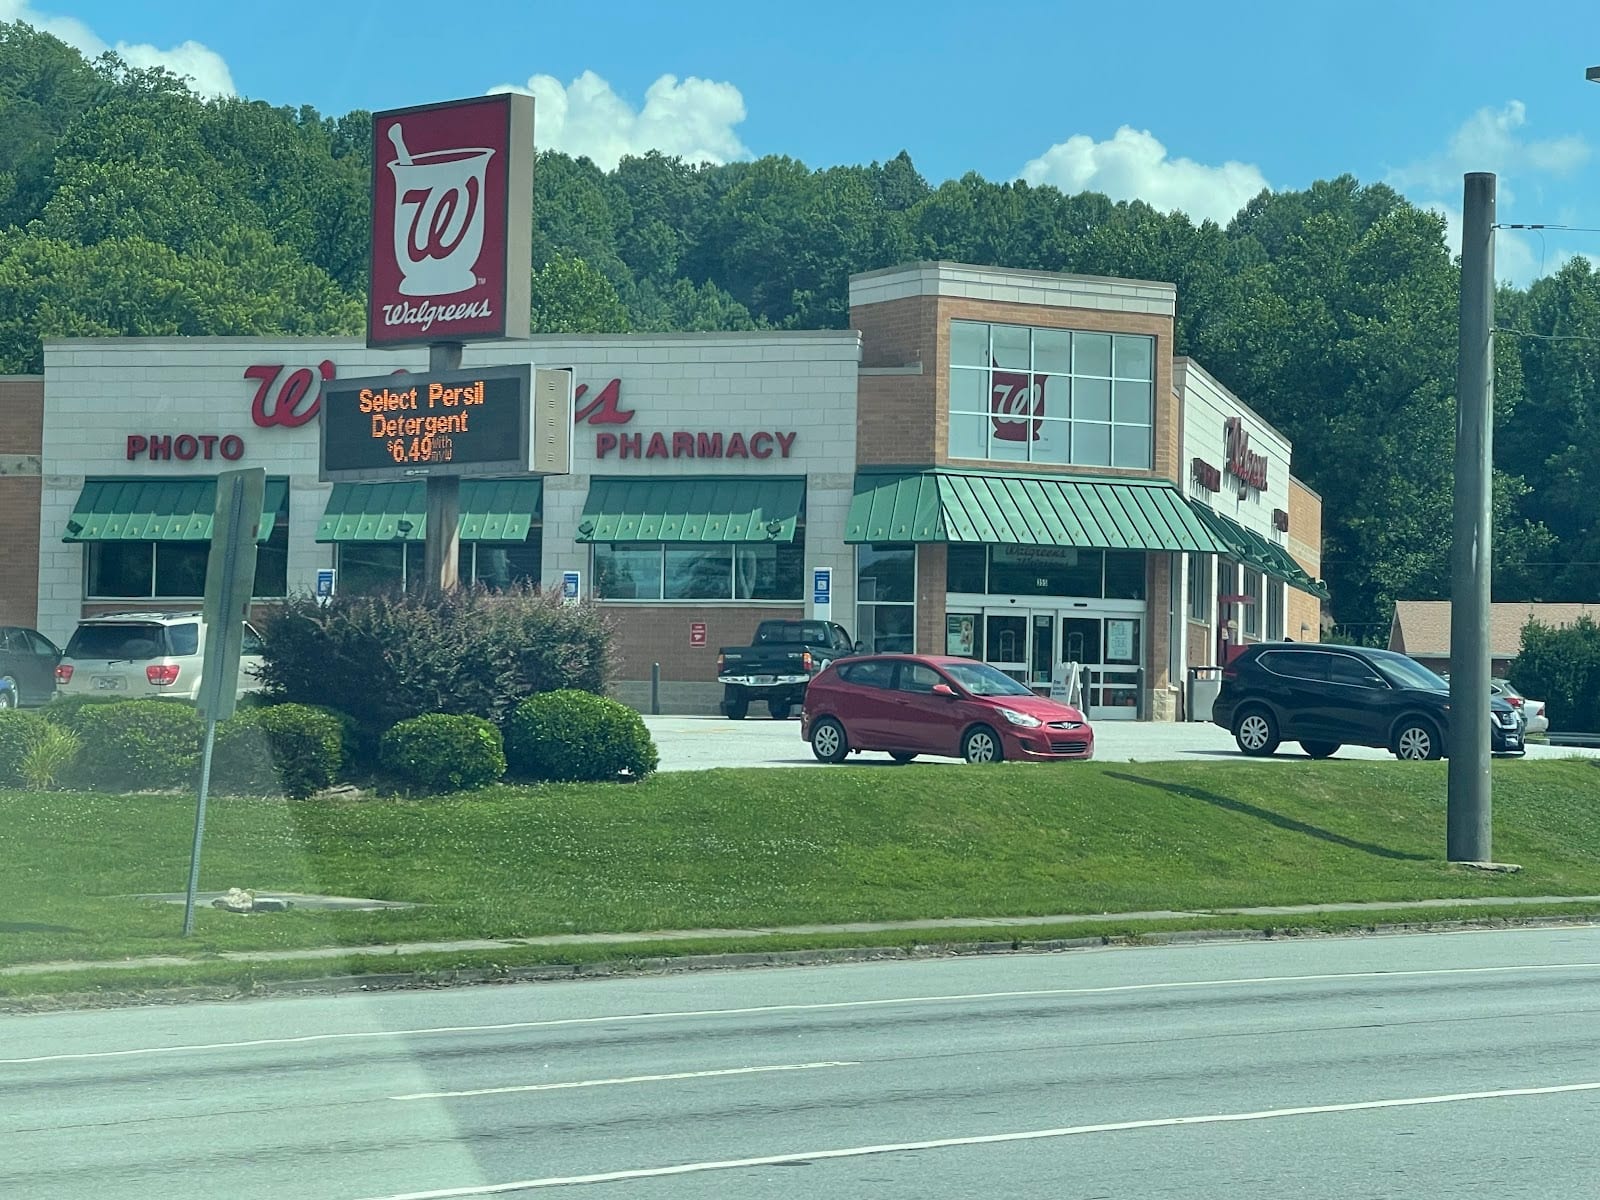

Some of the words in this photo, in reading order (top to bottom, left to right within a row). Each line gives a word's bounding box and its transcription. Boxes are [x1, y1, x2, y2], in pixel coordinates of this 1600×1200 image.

[382, 299, 493, 332] Walgreens
[359, 387, 418, 413] Select
[428, 381, 485, 408] Persil
[371, 410, 469, 438] Detergent
[126, 434, 246, 461] PHOTO
[387, 436, 433, 463] $6.49
[595, 431, 798, 460] PHARMACY
